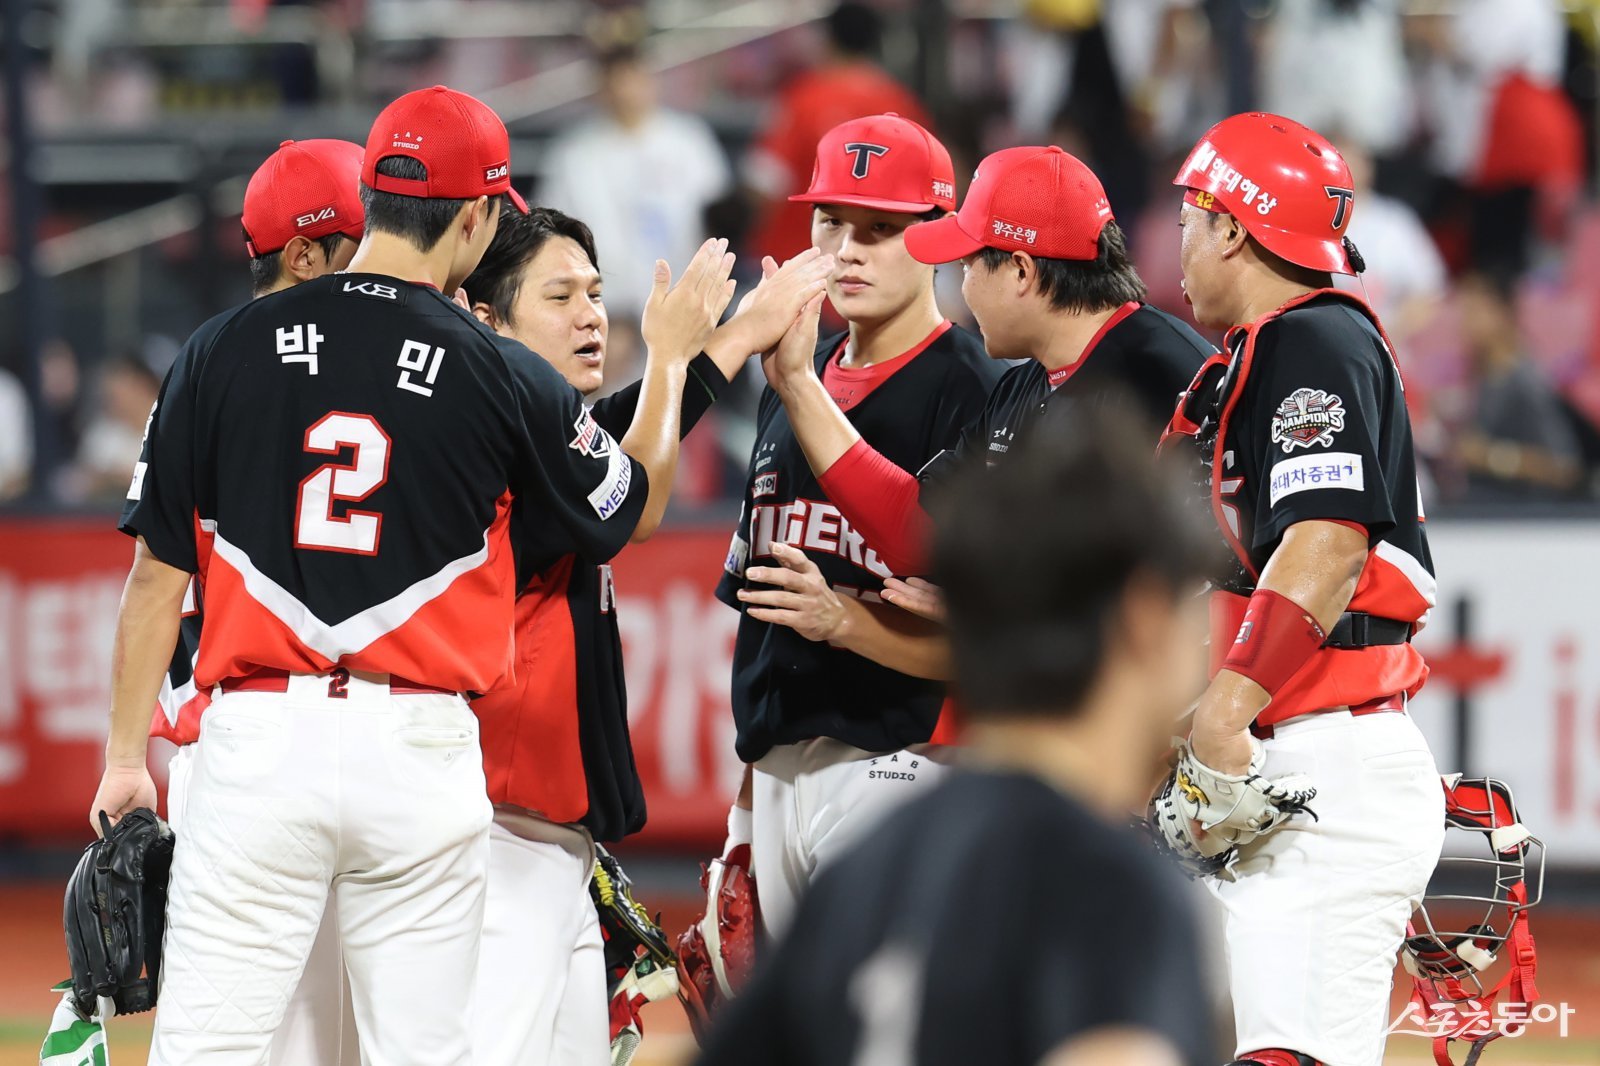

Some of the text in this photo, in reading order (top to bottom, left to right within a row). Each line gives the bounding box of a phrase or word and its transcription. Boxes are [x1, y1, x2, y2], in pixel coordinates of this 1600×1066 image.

[845, 142, 889, 179] T
[1195, 191, 1215, 209] 42
[1208, 158, 1278, 215] 현대해상
[296, 206, 336, 227] EV4
[1323, 186, 1354, 230] T
[992, 220, 1037, 244] 광주은행
[276, 323, 446, 397] 박 민
[1273, 409, 1343, 440] CHAMPIONS
[295, 410, 392, 556] 2
[1271, 464, 1342, 498] 현대차증권
[328, 666, 350, 700] 2
[868, 770, 916, 781] STUDIO
